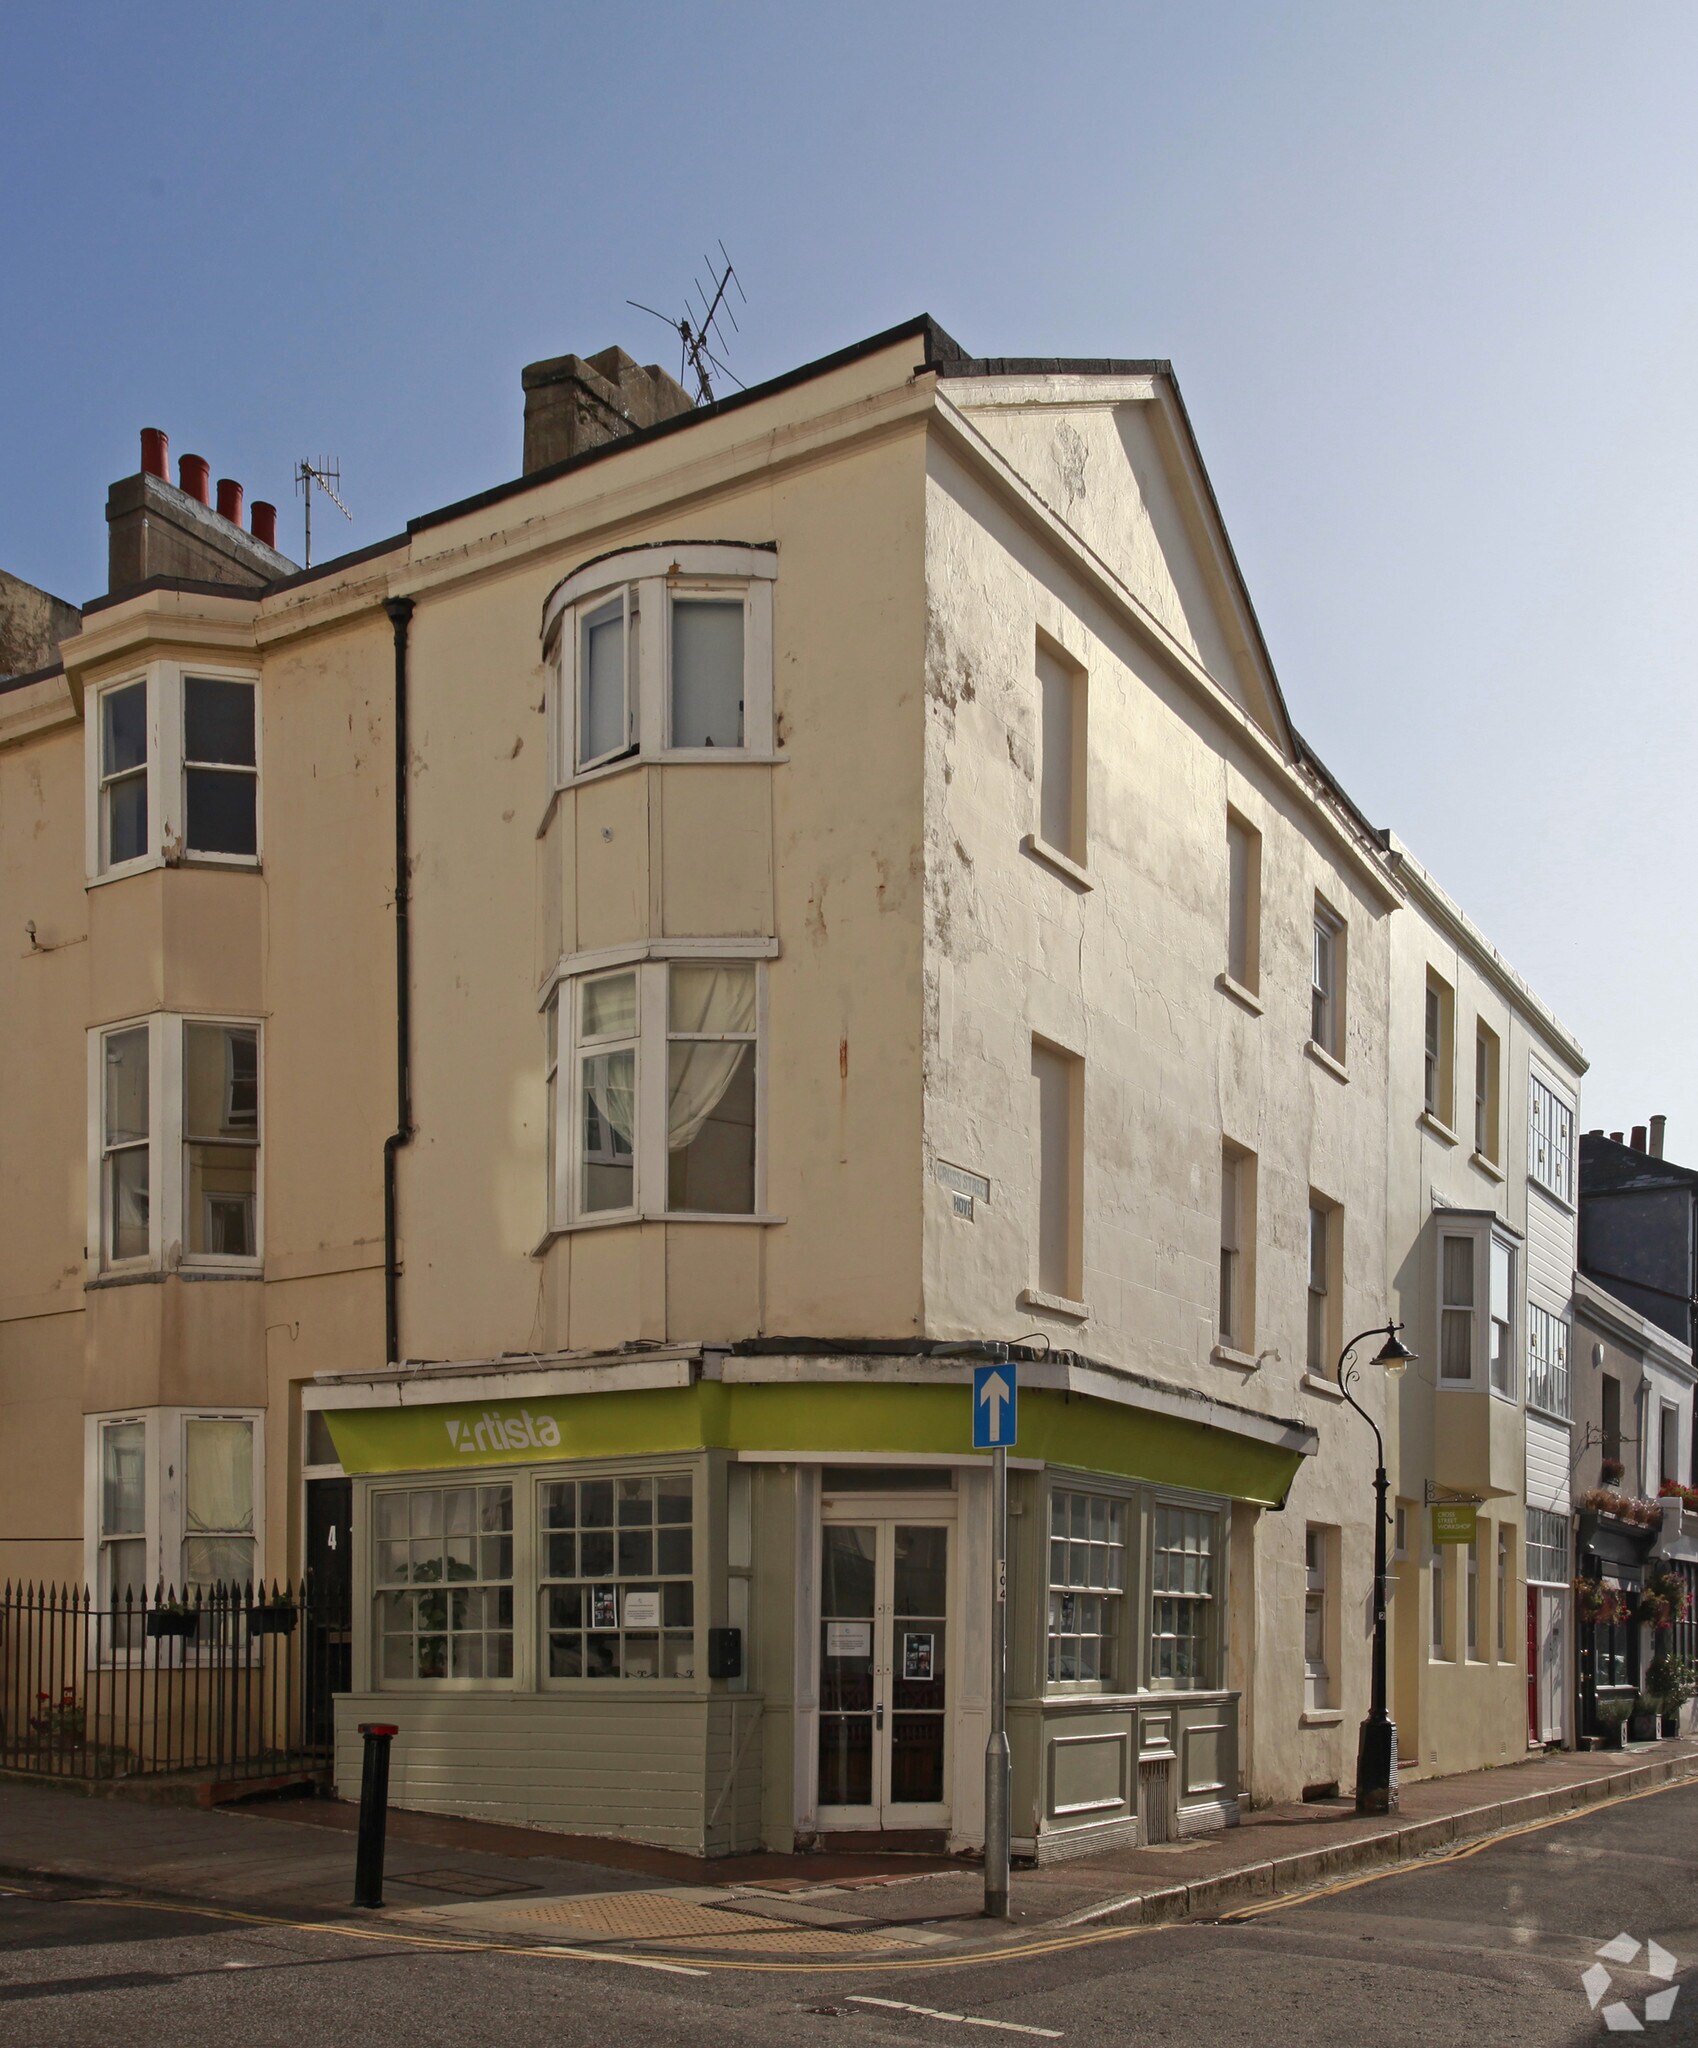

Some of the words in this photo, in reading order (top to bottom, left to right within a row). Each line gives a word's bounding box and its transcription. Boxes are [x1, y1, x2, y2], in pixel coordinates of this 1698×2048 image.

[954, 1196, 971, 1216] HOVE
[445, 1409, 561, 1453] Artista
[327, 1525, 337, 1550] 4
